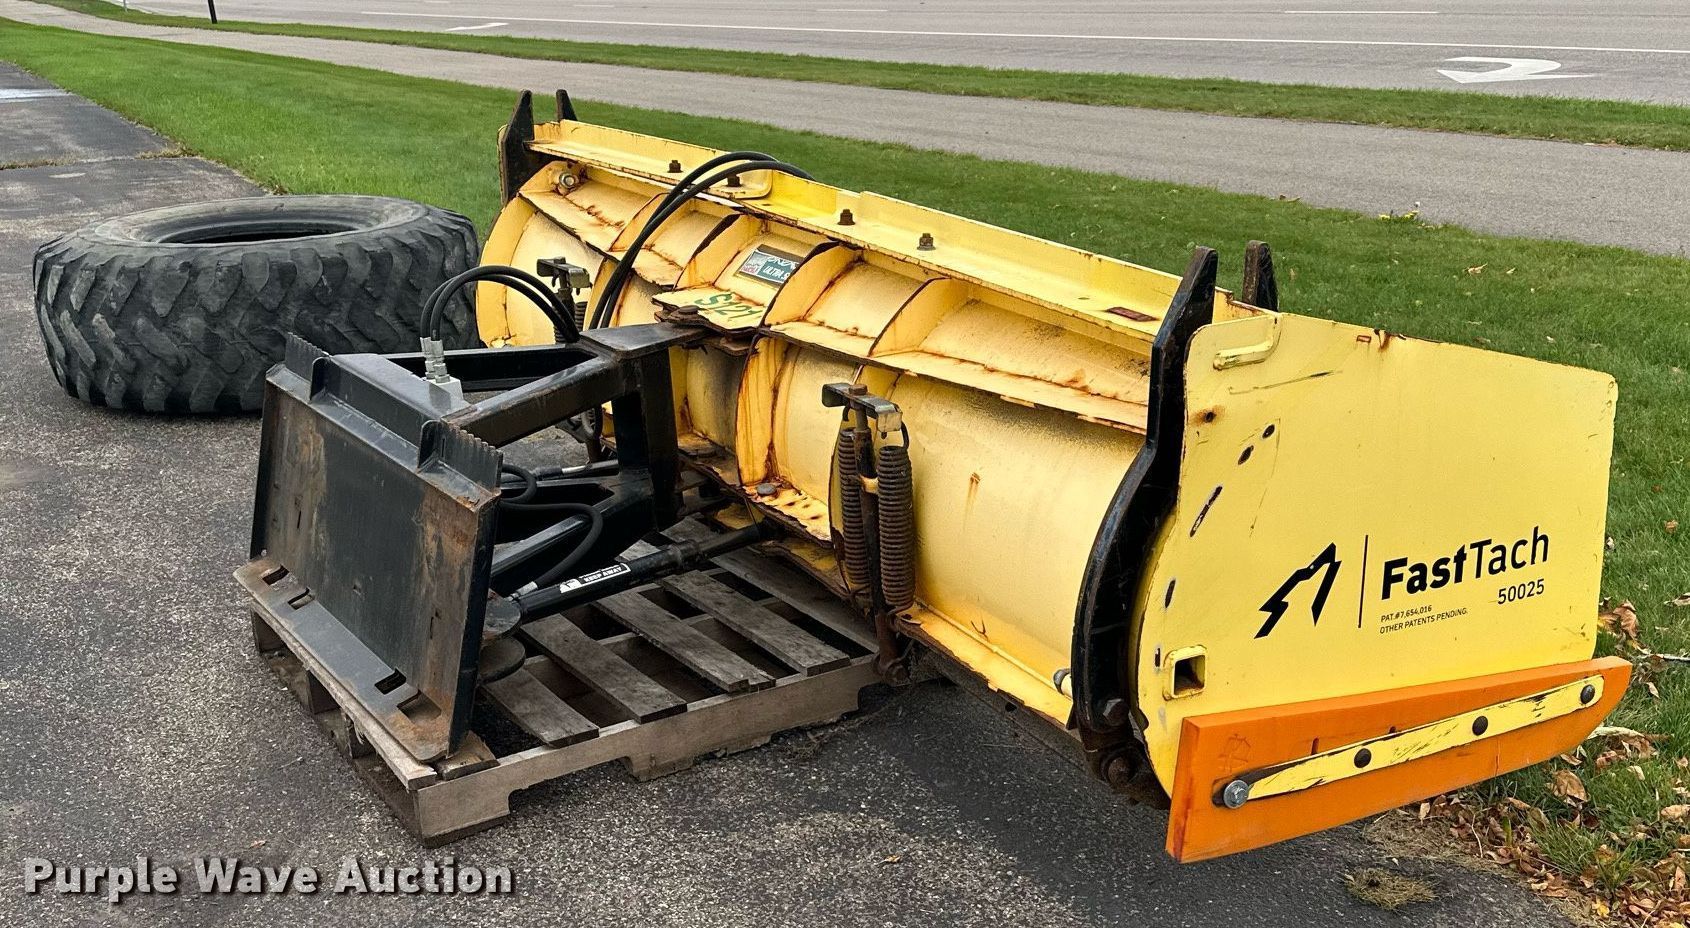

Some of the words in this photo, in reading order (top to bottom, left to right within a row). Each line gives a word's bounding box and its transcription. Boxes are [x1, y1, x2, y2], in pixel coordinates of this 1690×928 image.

[583, 573, 602, 582] KEEP
[602, 566, 622, 577] AWAY
[1381, 526, 1549, 600] FastTach
[1497, 578, 1545, 605] 50025
[1379, 622, 1404, 634] OTHER
[1404, 614, 1436, 629] PATENTS
